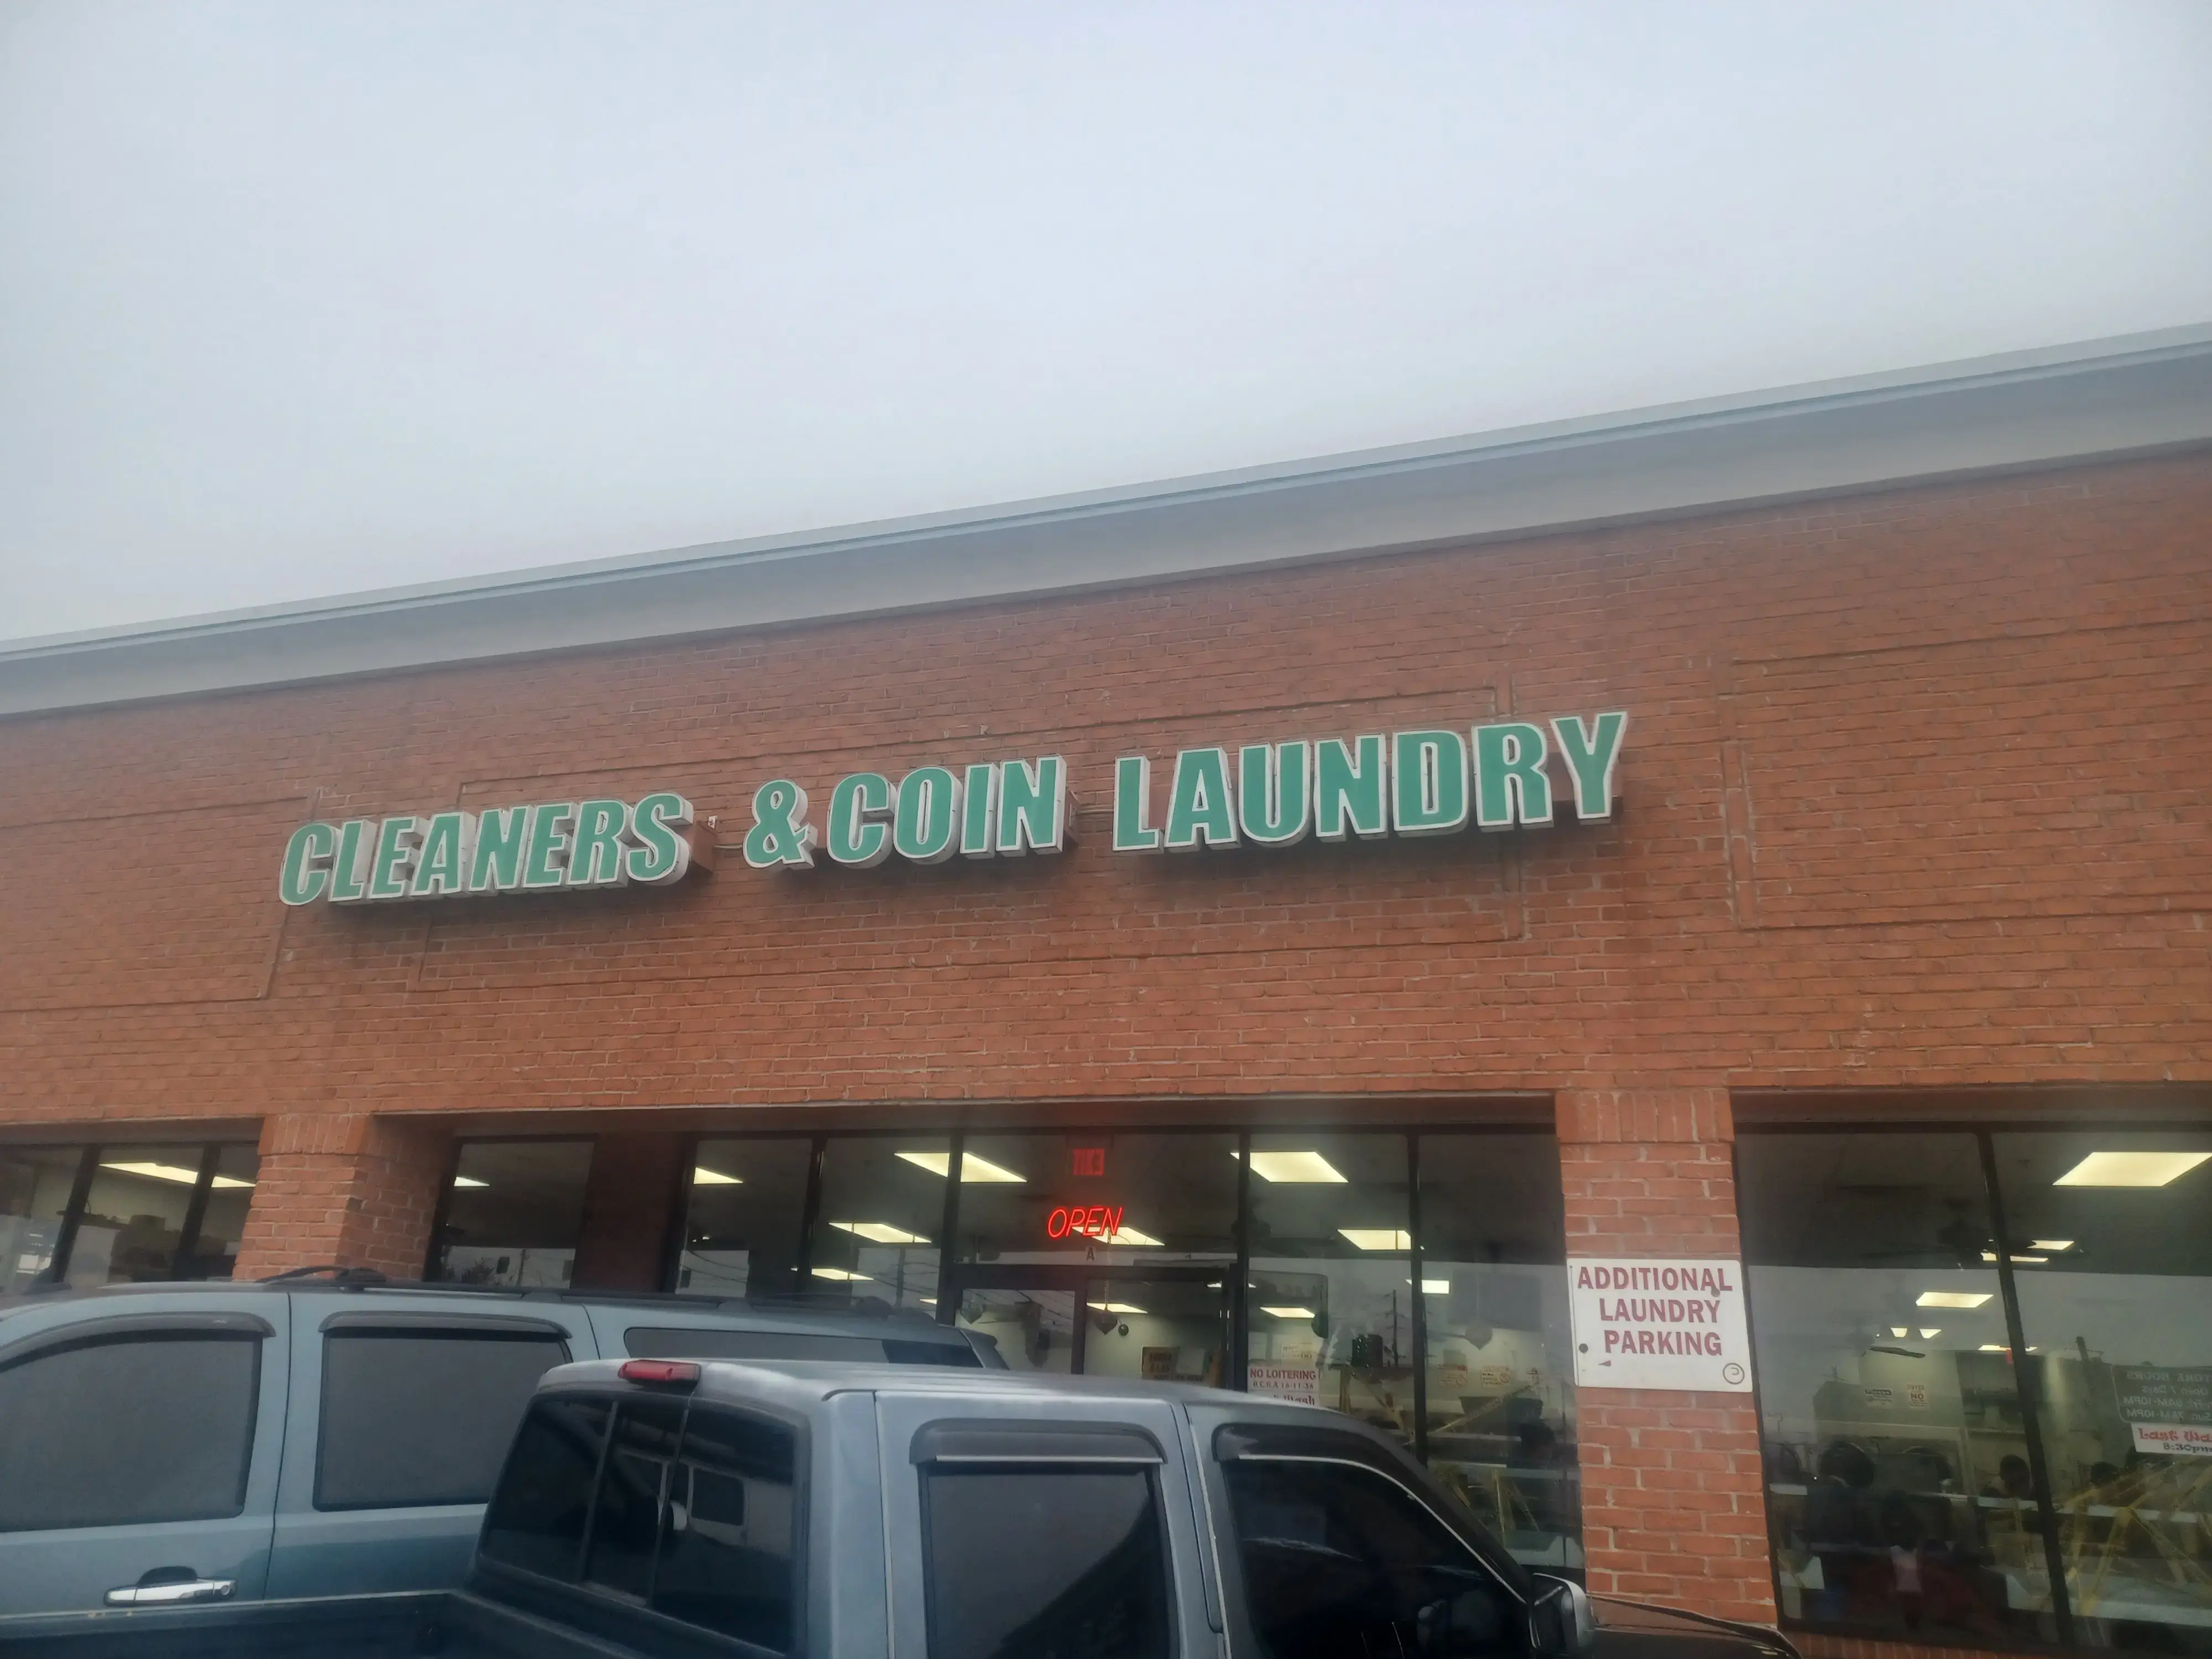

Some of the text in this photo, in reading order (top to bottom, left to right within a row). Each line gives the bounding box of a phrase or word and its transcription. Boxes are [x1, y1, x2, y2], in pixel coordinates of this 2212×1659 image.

[279, 711, 1628, 906] CLEANERS & COIN LAUNDRY
[1047, 1206, 1124, 1239] OPEN
[1577, 1266, 1733, 1291] ADDITIONAL
[1599, 1298, 1721, 1323] LAUNDRY
[1604, 1329, 1723, 1356] PARKING
[1250, 1369, 1316, 1380] NO LOITERING
